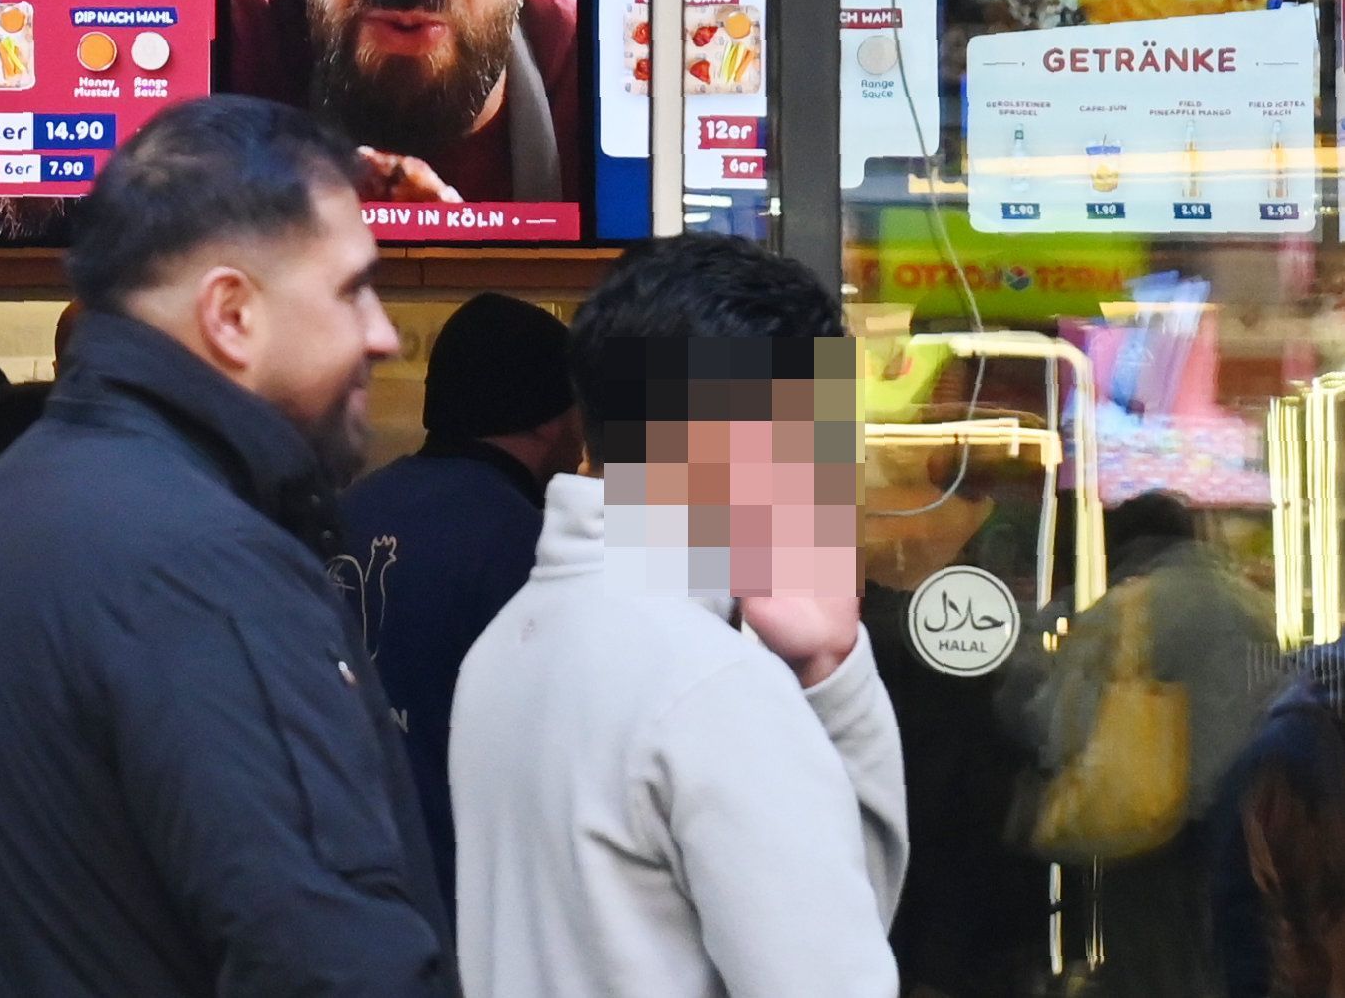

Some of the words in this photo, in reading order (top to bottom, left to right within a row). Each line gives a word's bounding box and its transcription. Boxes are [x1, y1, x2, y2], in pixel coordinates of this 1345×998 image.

[74, 11, 96, 24] DIP
[97, 11, 135, 24] NACH
[135, 10, 173, 24] WAHL
[1042, 40, 1237, 73] GETRÄNKE
[45, 120, 103, 141] 14.90
[706, 120, 753, 140] 12er
[4, 161, 33, 176] 6er
[49, 161, 84, 176] 7.90
[729, 158, 758, 173] 6er
[417, 209, 440, 225] IN
[447, 208, 504, 227] KÖLN
[923, 589, 1005, 633] حلال
[938, 639, 988, 653] HALAL
